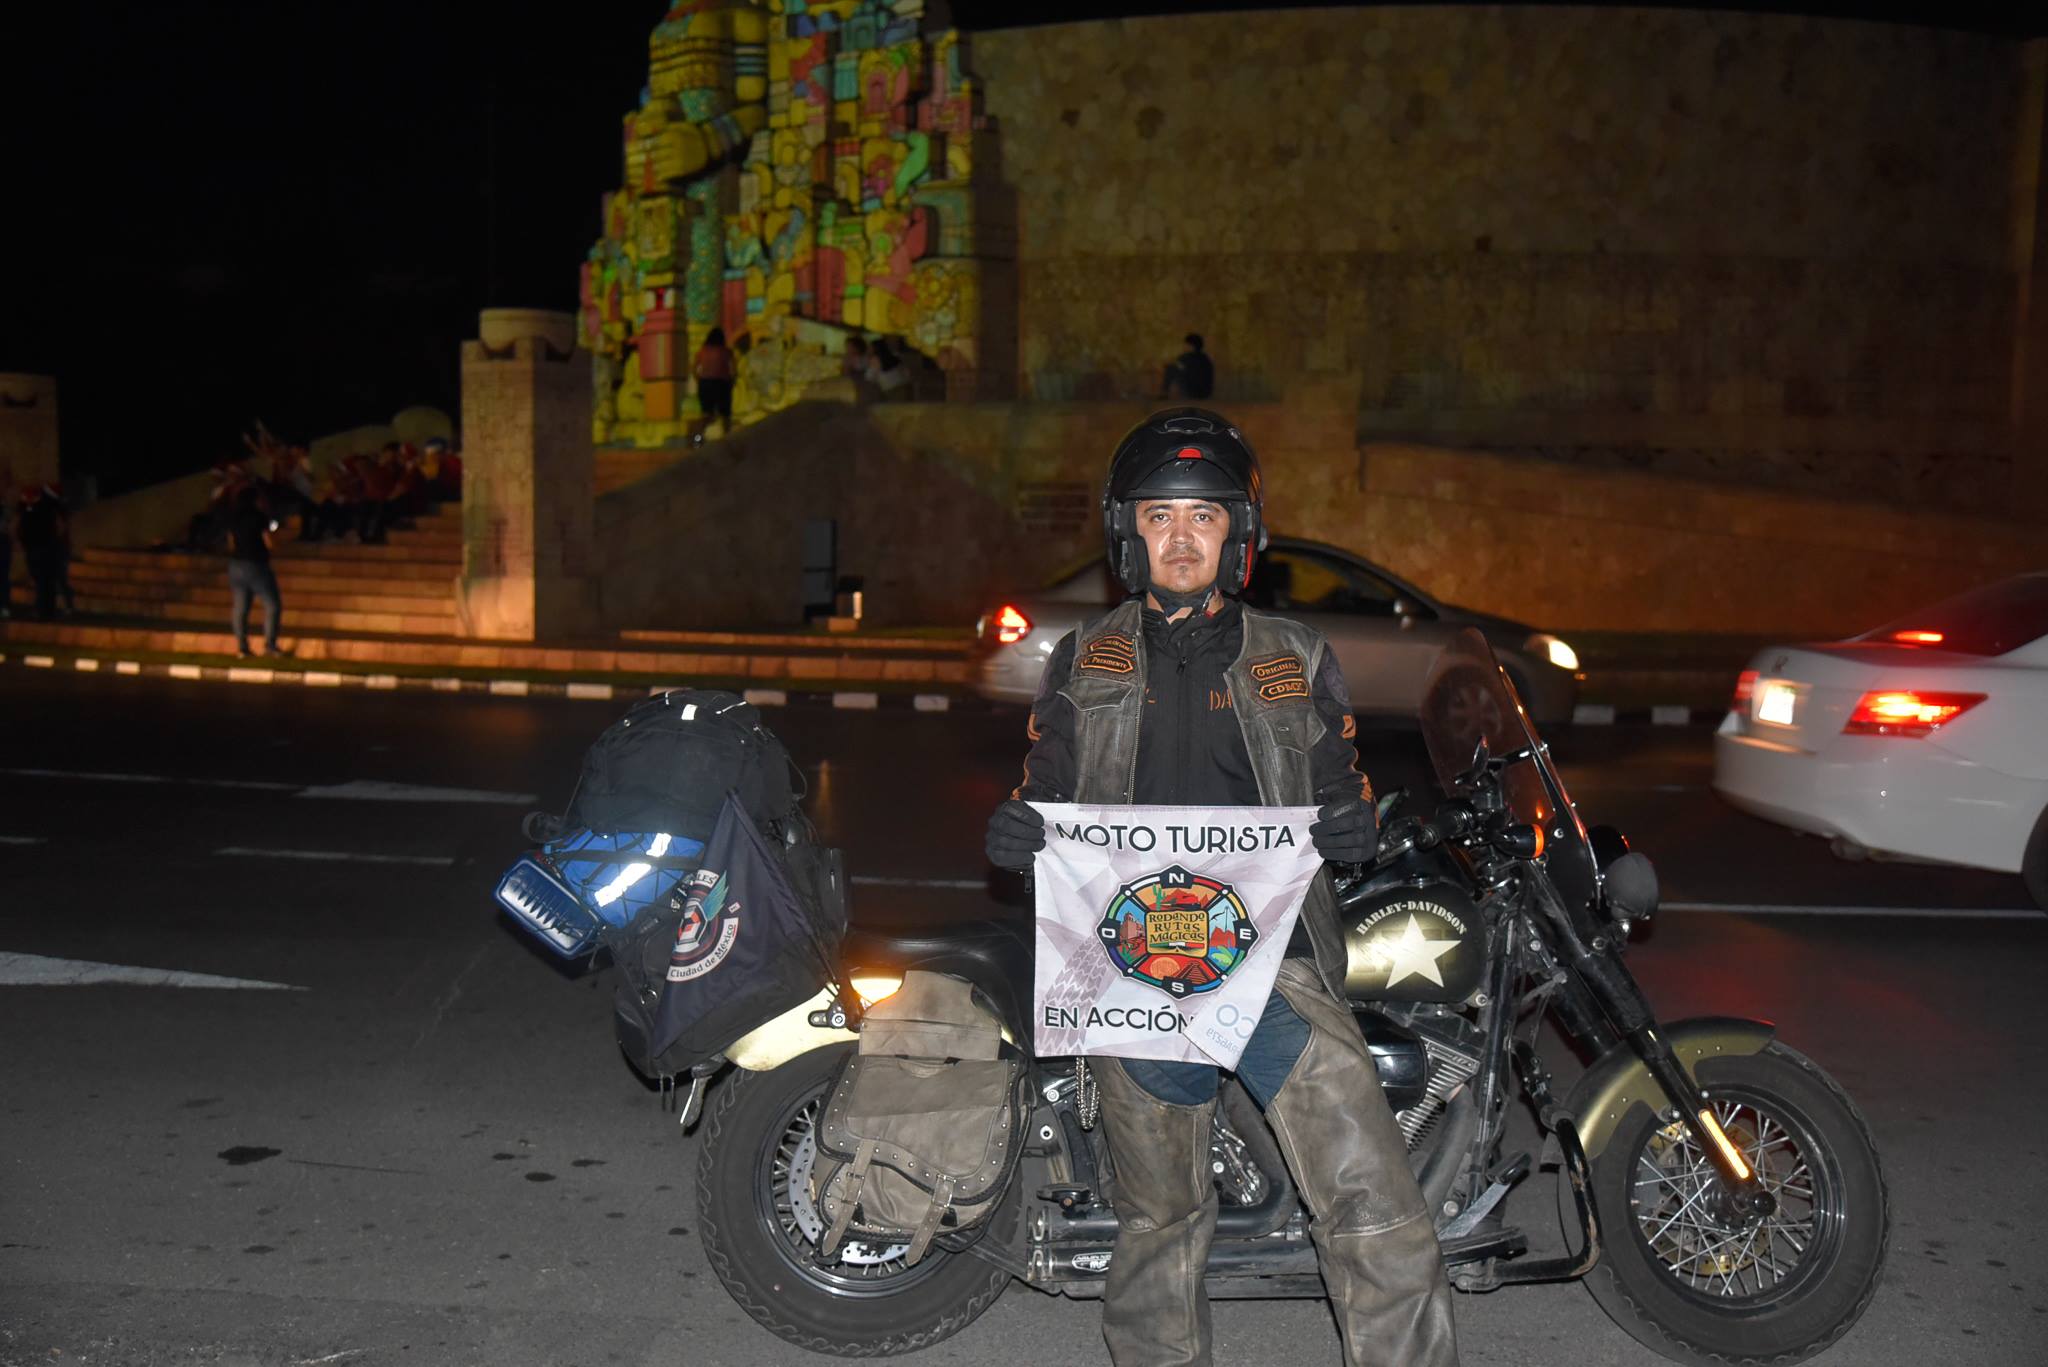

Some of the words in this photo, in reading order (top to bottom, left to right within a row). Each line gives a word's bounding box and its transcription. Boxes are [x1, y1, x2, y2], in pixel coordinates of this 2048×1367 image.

[1256, 662, 1298, 677] ORIGINAL
[1055, 823, 1156, 852] MOTO
[1165, 825, 1295, 853] TURISTA
[1169, 873, 1185, 884] N
[1356, 901, 1467, 936] HARLEY-DAVIDSON
[1239, 928, 1252, 940] E
[670, 964, 703, 978] Ciudad
[705, 957, 716, 968] de
[716, 924, 735, 958] México
[1171, 982, 1185, 993] S
[1045, 1006, 1078, 1029] EN
[1086, 1005, 1194, 1034] ACCIÓN
